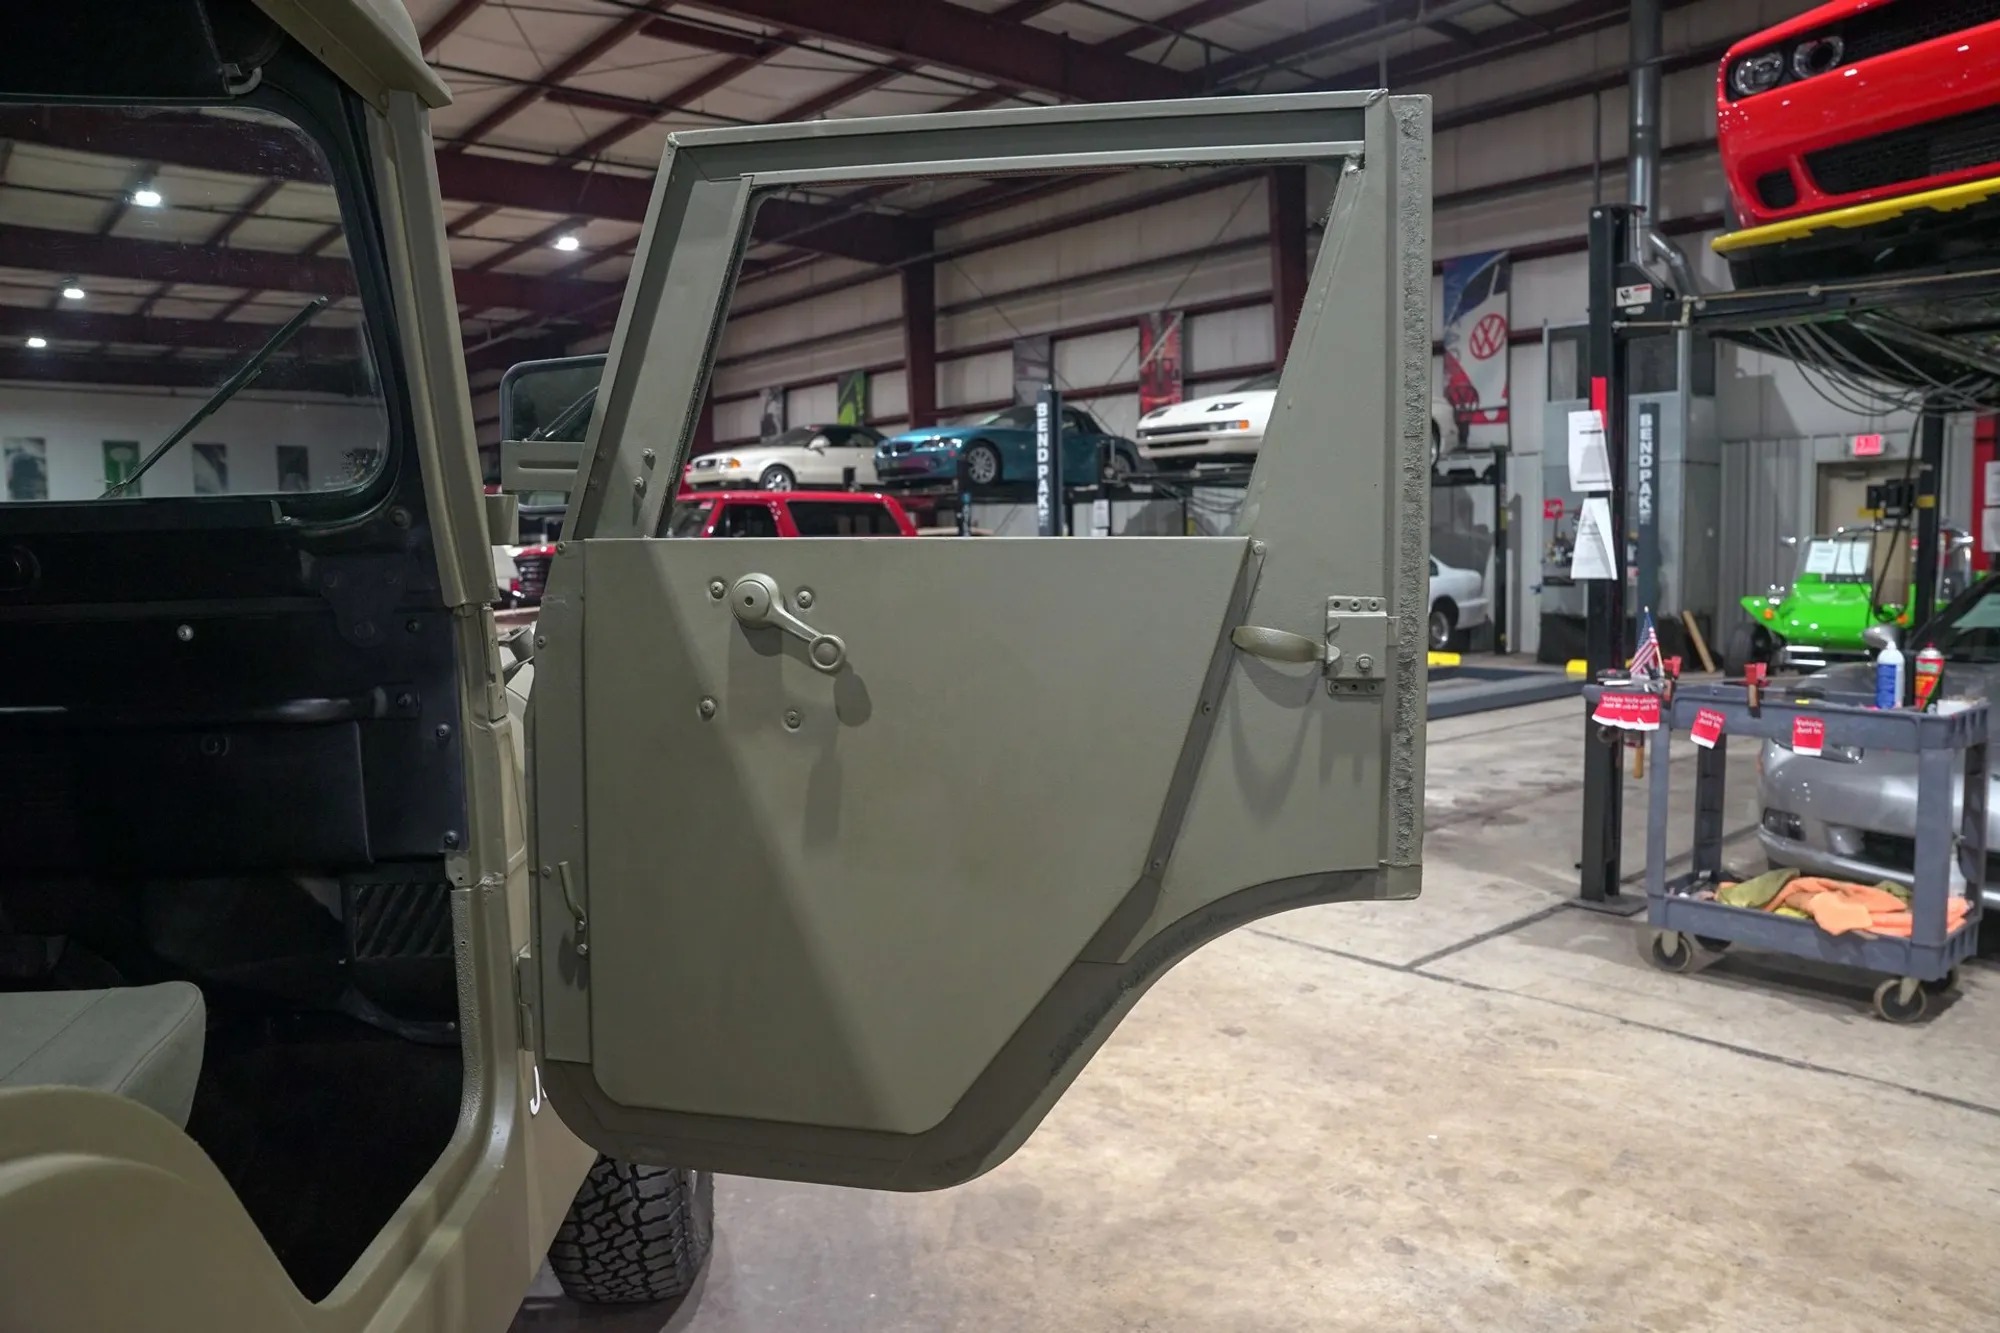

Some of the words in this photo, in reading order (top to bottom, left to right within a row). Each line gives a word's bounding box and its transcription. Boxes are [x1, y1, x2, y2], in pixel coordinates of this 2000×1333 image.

[1036, 402, 1049, 508] BENDPAK
[1639, 413, 1652, 510] BENDPAK
[1700, 710, 1723, 722] Vehicle
[1796, 719, 1823, 728] Vehicle
